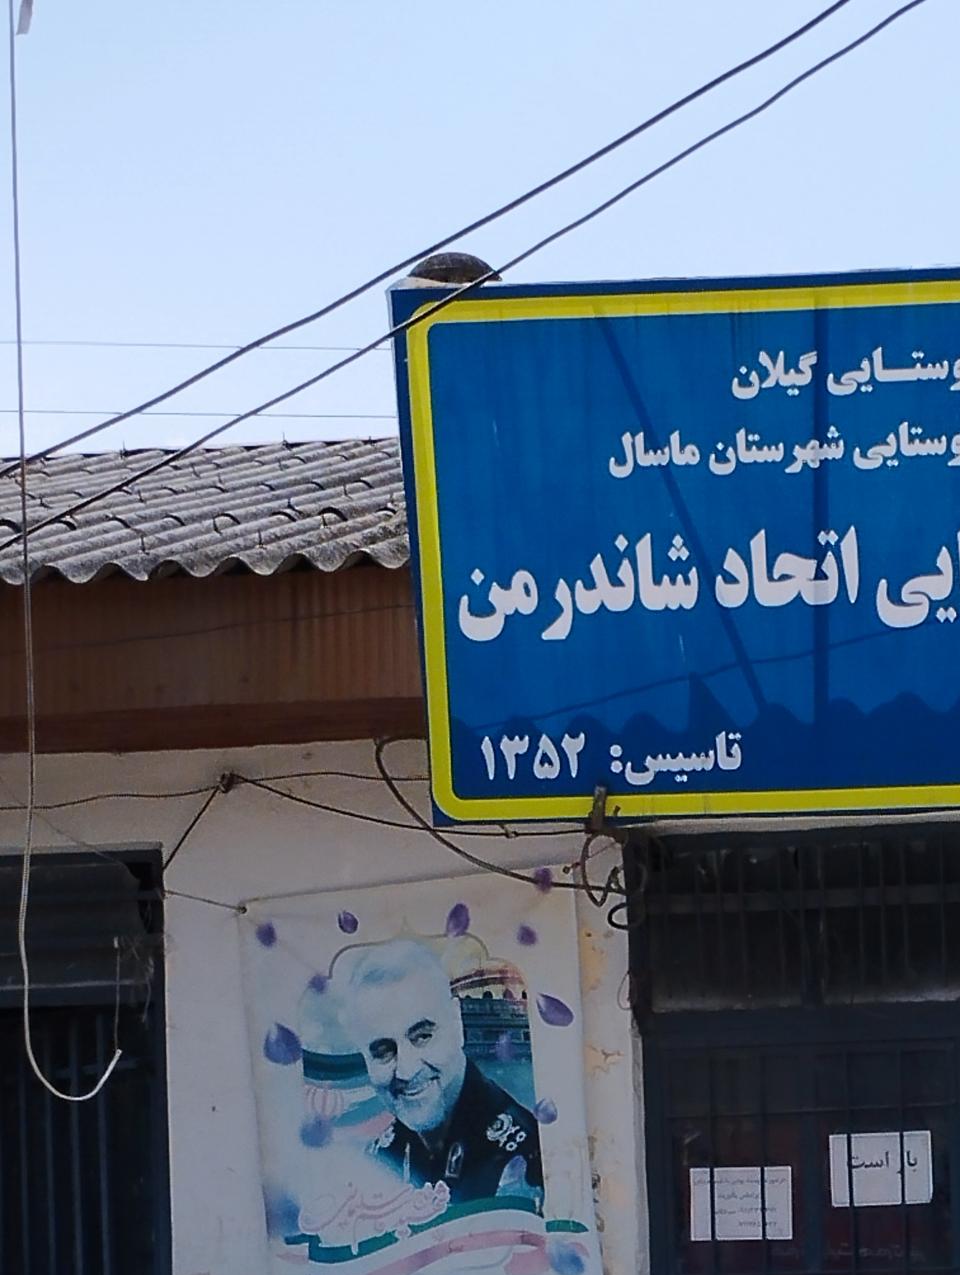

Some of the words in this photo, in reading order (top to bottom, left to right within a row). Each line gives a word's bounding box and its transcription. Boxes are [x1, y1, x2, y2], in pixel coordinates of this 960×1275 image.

[731, 350, 818, 399] گیلان
[609, 431, 701, 478] ماسال
[708, 427, 845, 475] شهرستان
[458, 533, 699, 642] شاندرمن
[715, 526, 859, 608] اتحاد
[480, 732, 585, 780] ۱۳۵۲
[609, 731, 742, 786] تاسیس:
[896, 1150, 919, 1175] با
